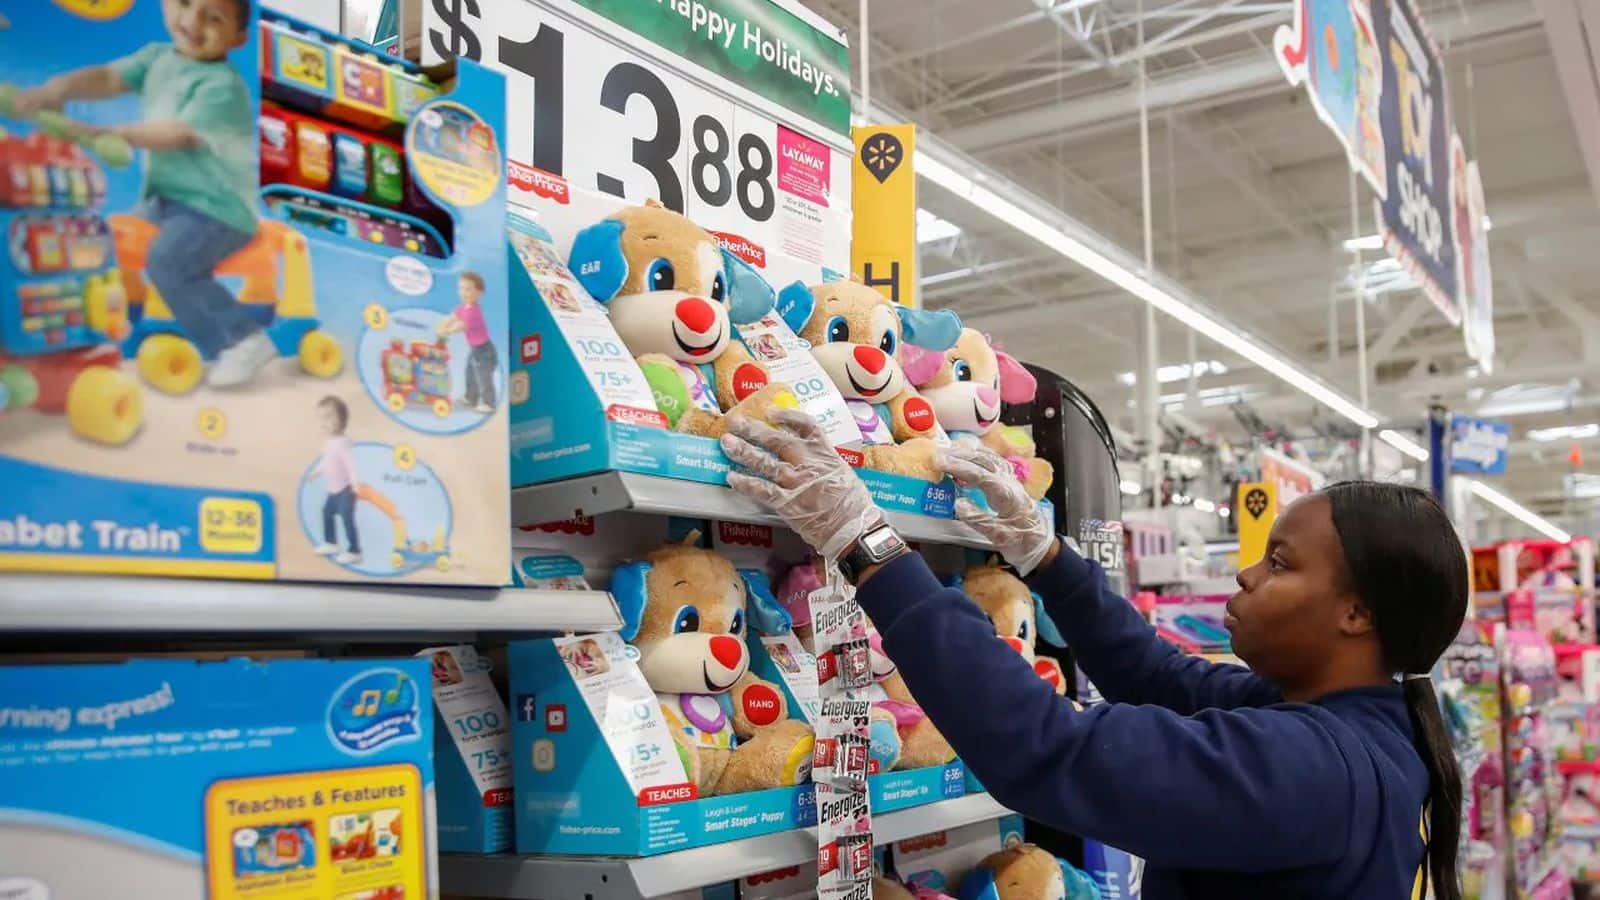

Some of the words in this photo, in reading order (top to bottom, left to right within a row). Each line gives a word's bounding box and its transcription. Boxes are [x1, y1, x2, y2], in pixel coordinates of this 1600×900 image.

[743, 20, 840, 97] Holidays.
[782, 143, 825, 171] LAYAWAY
[507, 166, 566, 194] sher-Price
[580, 260, 601, 276] EAR
[575, 339, 621, 357] 100
[594, 371, 633, 387] 75+
[794, 377, 824, 396] 00
[652, 389, 679, 411] OOT
[614, 408, 662, 426] TEACHES
[675, 454, 702, 468] Smart
[838, 452, 859, 466] CHES
[1079, 531, 1111, 542] MADE
[816, 657, 828, 671] 10
[748, 699, 775, 710] HAND
[820, 697, 870, 721] Energizer
[454, 711, 499, 736] 100
[815, 742, 827, 756] 10
[225, 794, 306, 815] Teaches
[312, 790, 324, 806] &
[330, 784, 406, 804] Features
[646, 786, 692, 802] TEACHES
[820, 791, 867, 825] Energizer
[703, 818, 729, 833] Smart
[730, 814, 758, 829] Stages
[761, 811, 785, 824] Puppy
[819, 848, 830, 862] 10
